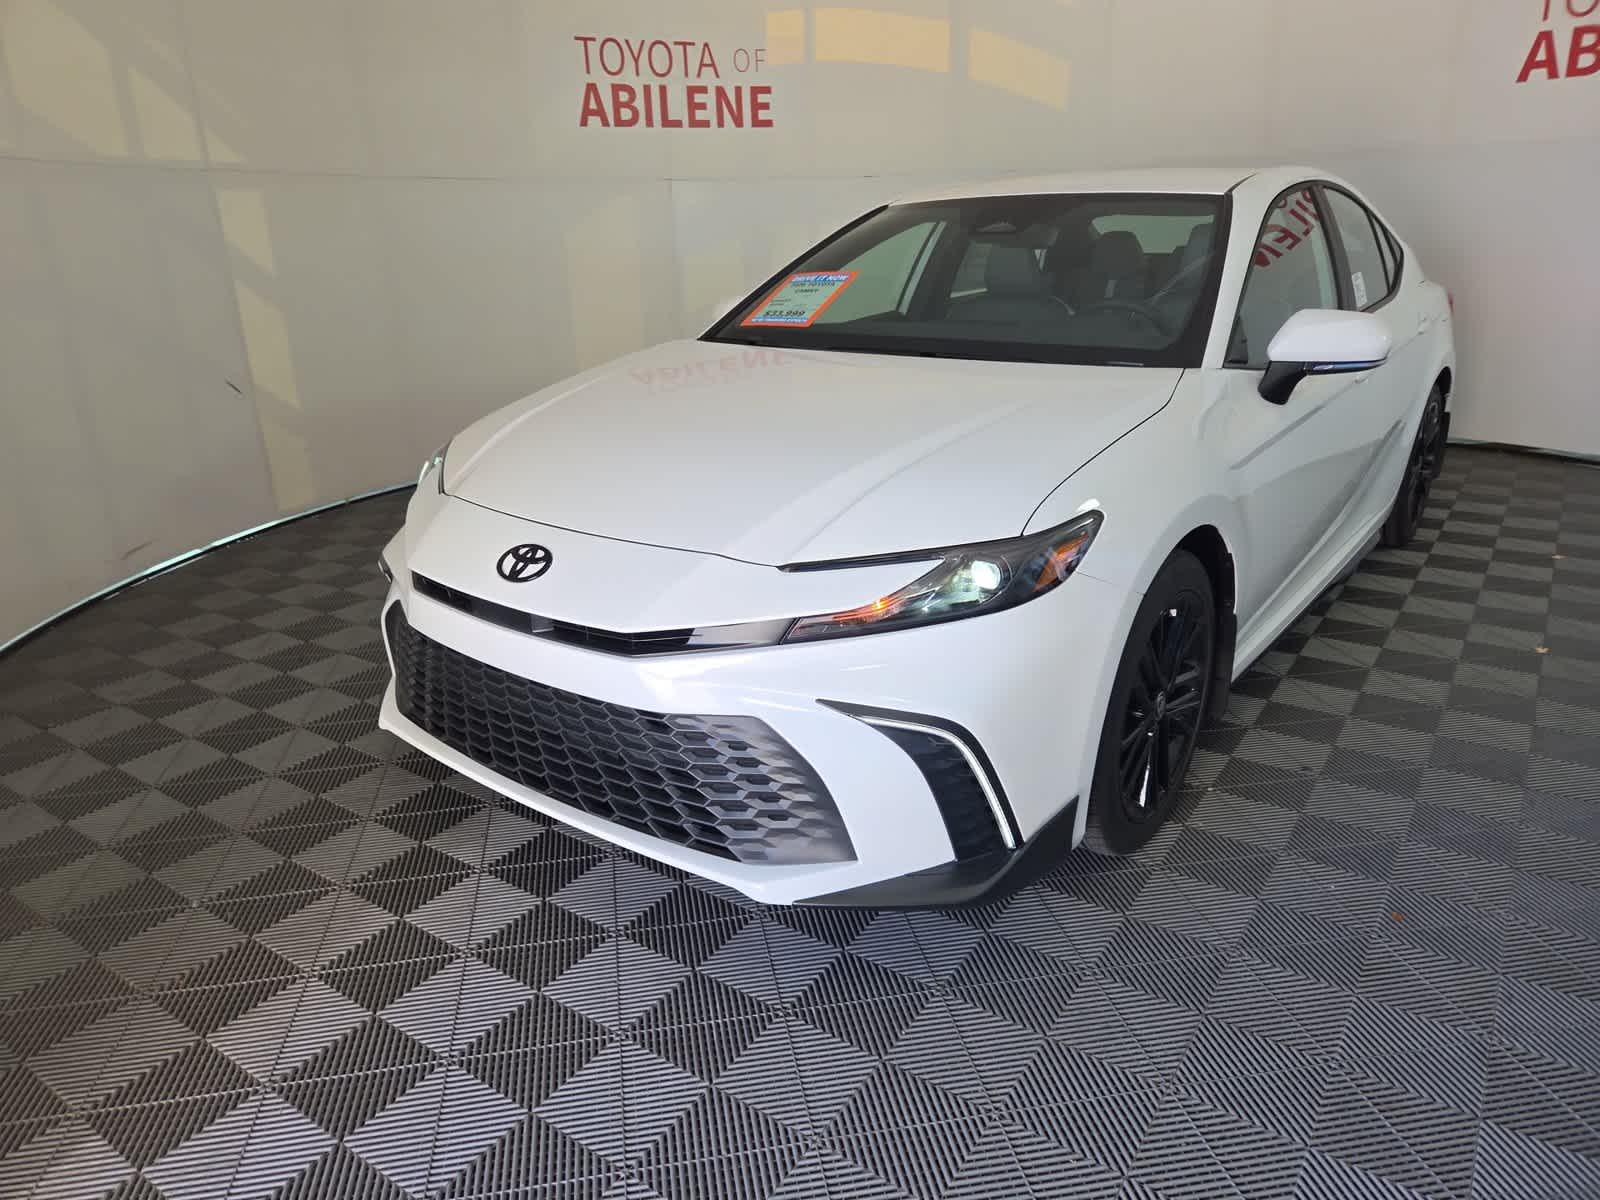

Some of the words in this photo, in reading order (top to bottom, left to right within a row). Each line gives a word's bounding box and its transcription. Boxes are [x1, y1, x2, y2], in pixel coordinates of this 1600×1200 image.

[574, 36, 720, 78] TOYOTA
[733, 48, 767, 73] OF
[1516, 24, 1600, 84] AB
[579, 82, 774, 129] ABILENE
